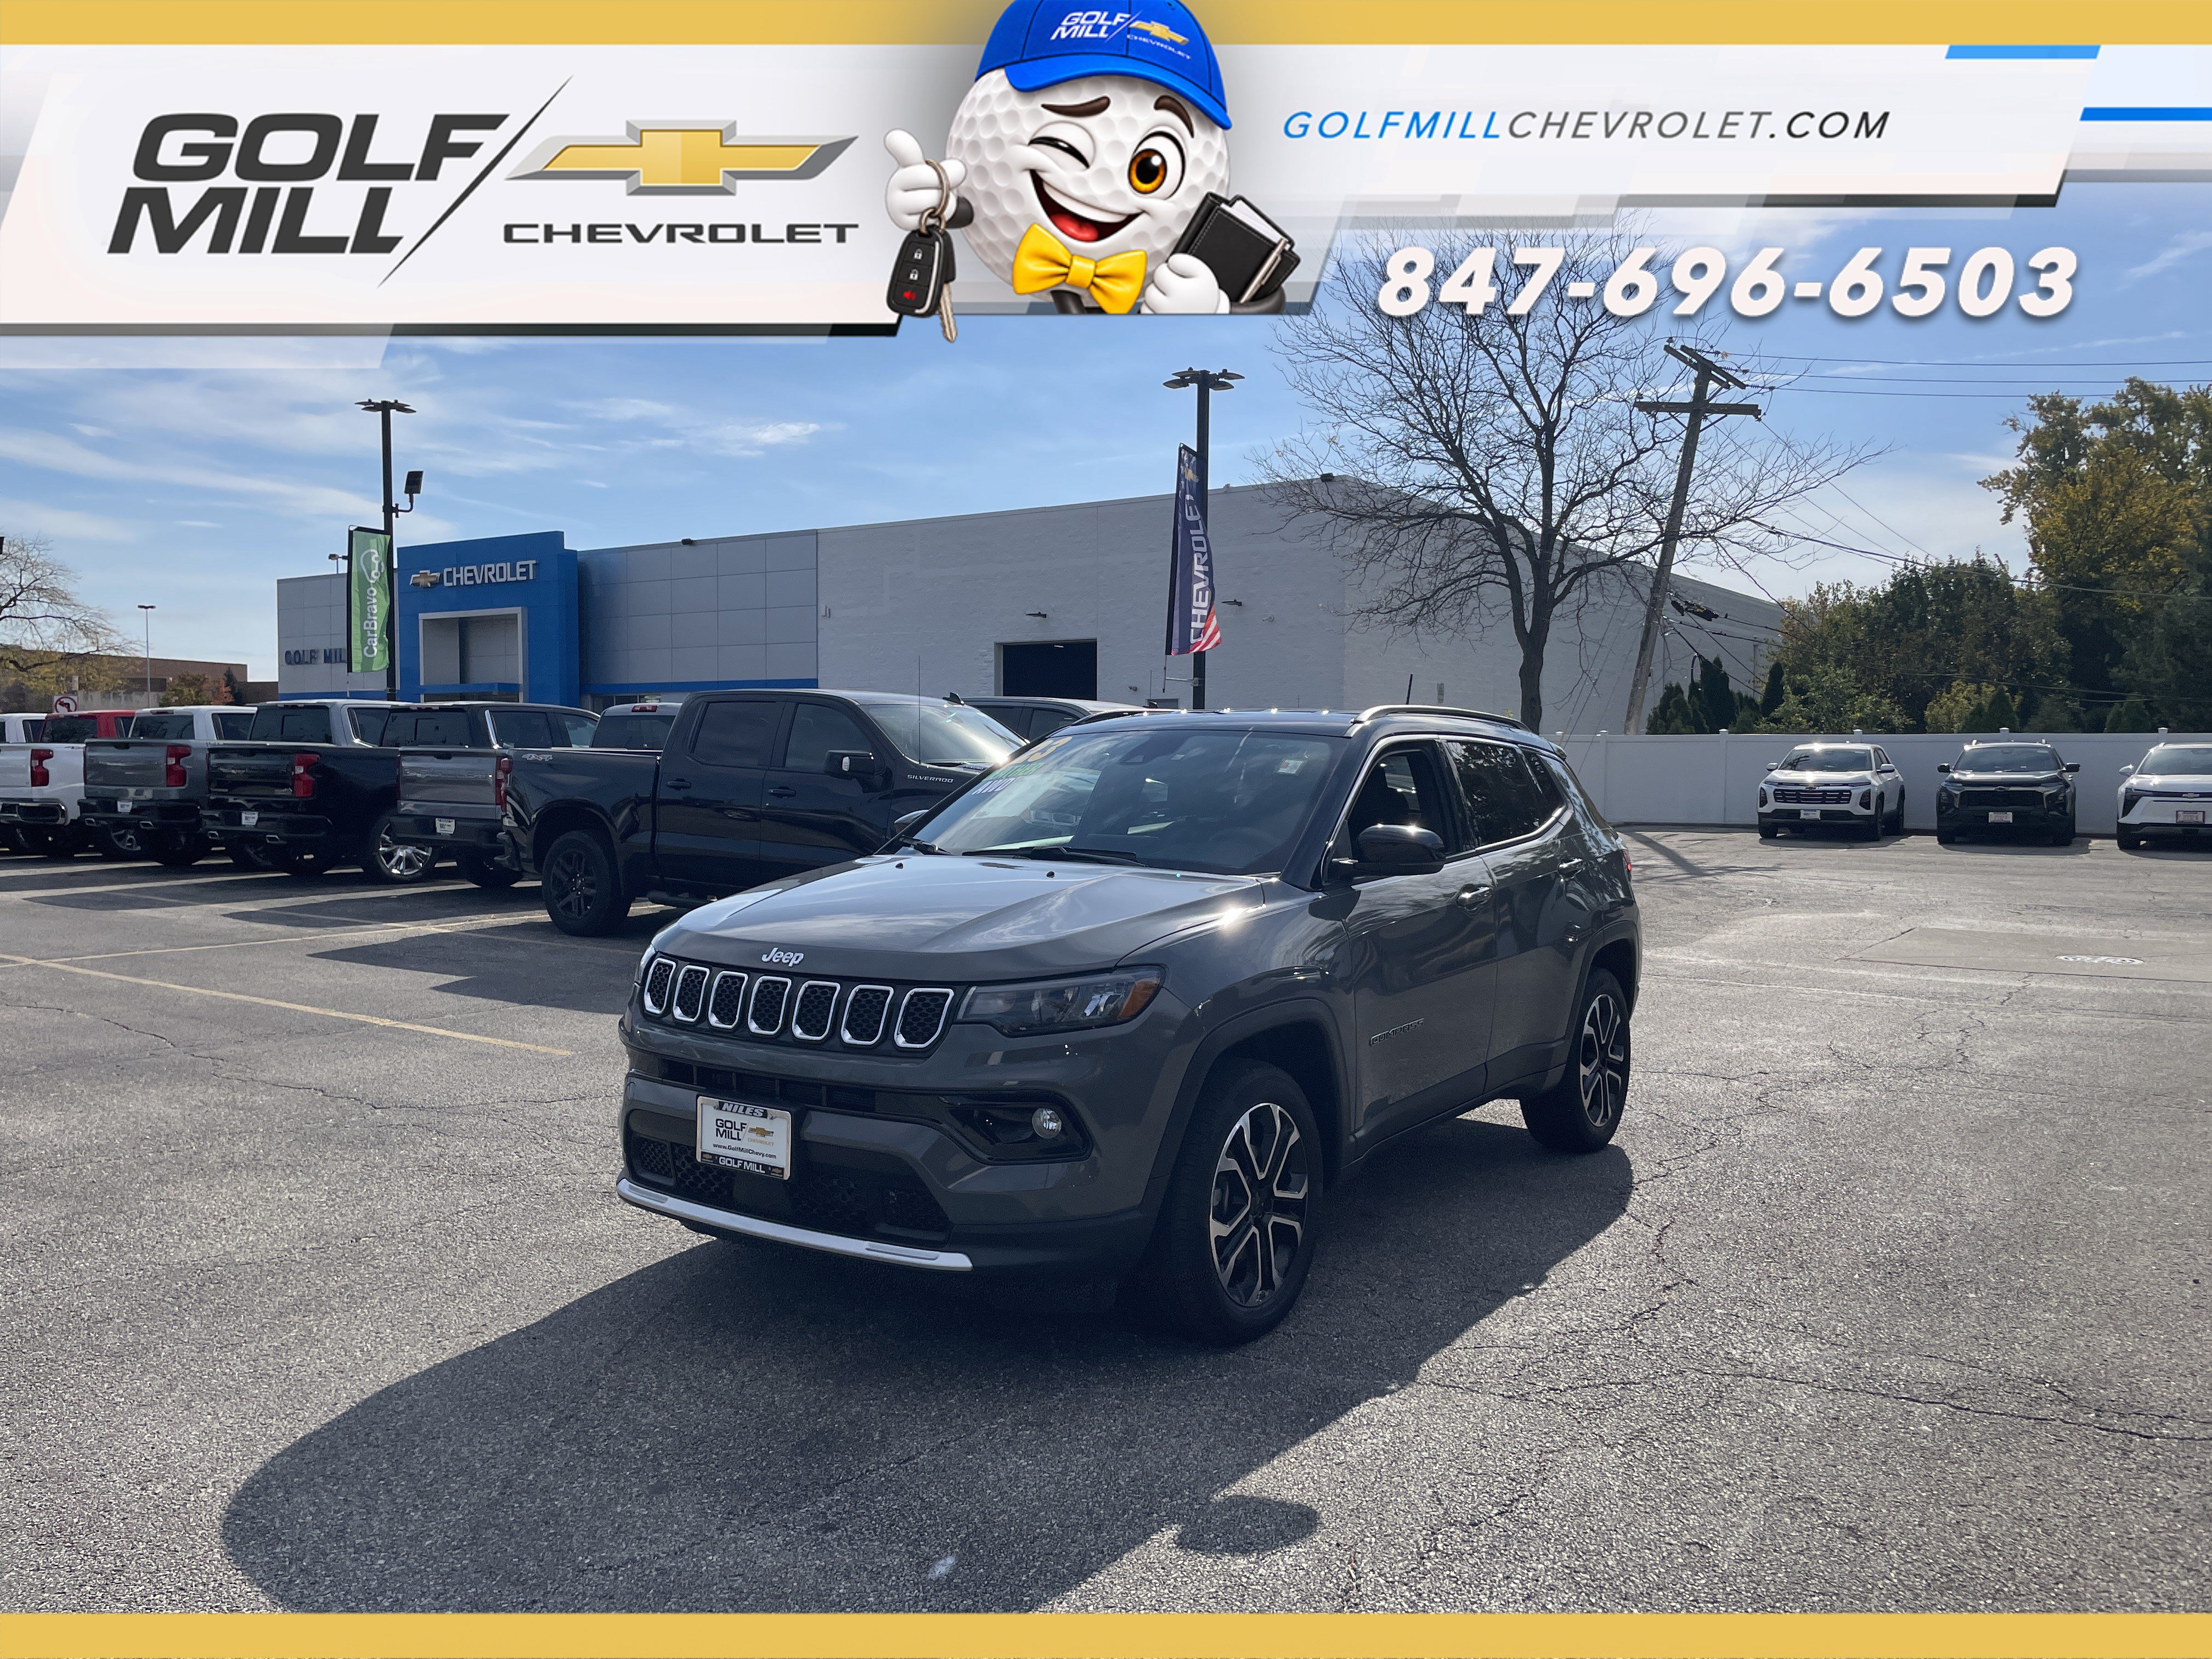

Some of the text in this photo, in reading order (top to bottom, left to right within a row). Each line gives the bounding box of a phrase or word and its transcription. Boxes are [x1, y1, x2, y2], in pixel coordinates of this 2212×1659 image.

[443, 560, 537, 586] CHEVROLET
[363, 587, 378, 658] CarBravo
[285, 649, 319, 665] GOLF
[907, 774, 954, 783] SILVERADO
[971, 777, 1016, 795] AWD
[761, 947, 804, 967] Jeep
[1369, 1018, 1424, 1046] COMPASS
[721, 1103, 764, 1117] NILES
[715, 1118, 747, 1132] GOLF
[715, 1127, 742, 1141] MILL
[713, 1143, 777, 1159] www.GolfMillChevy.com
[719, 1156, 765, 1174] GOLF MILL
